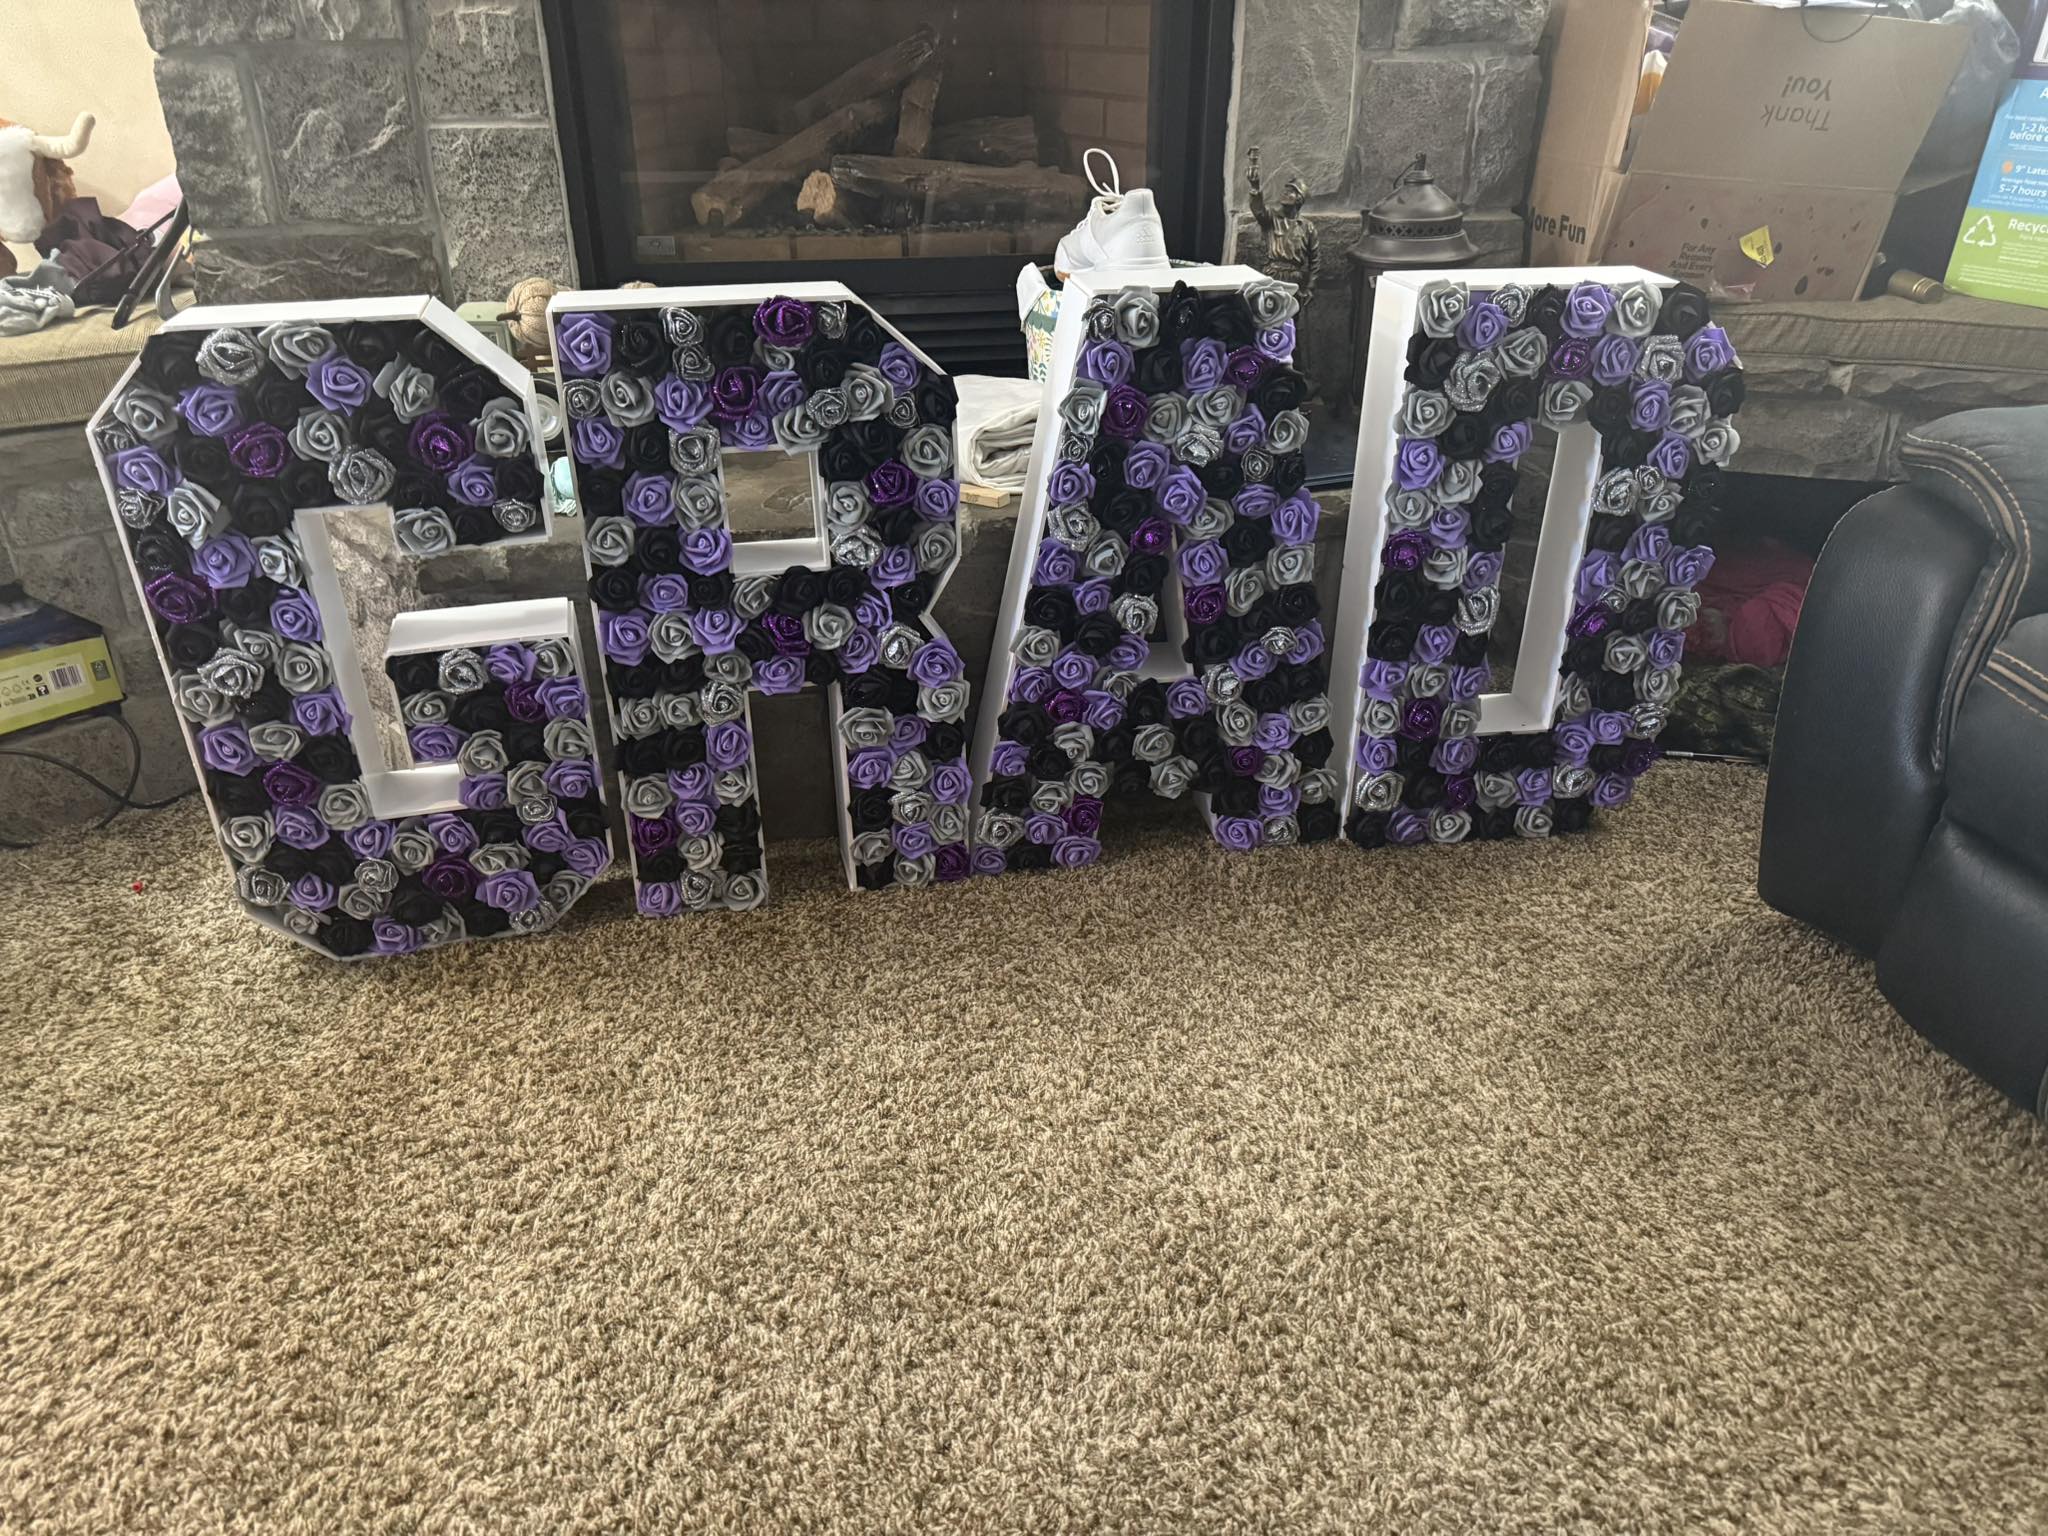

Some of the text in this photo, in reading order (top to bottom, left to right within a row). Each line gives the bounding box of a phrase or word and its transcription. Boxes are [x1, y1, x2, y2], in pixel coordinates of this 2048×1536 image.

[1781, 75, 1832, 102] You!
[1760, 104, 1831, 132] Thank
[2009, 129, 2043, 142] before
[2020, 122, 2037, 133] 1-2
[2026, 166, 2048, 176] Late
[2017, 185, 2048, 198] hours
[1558, 214, 1587, 245] Fun
[2007, 217, 2048, 236] Recyc
[1681, 242, 1717, 256] For Any
[87, 264, 1746, 966] GRAD
